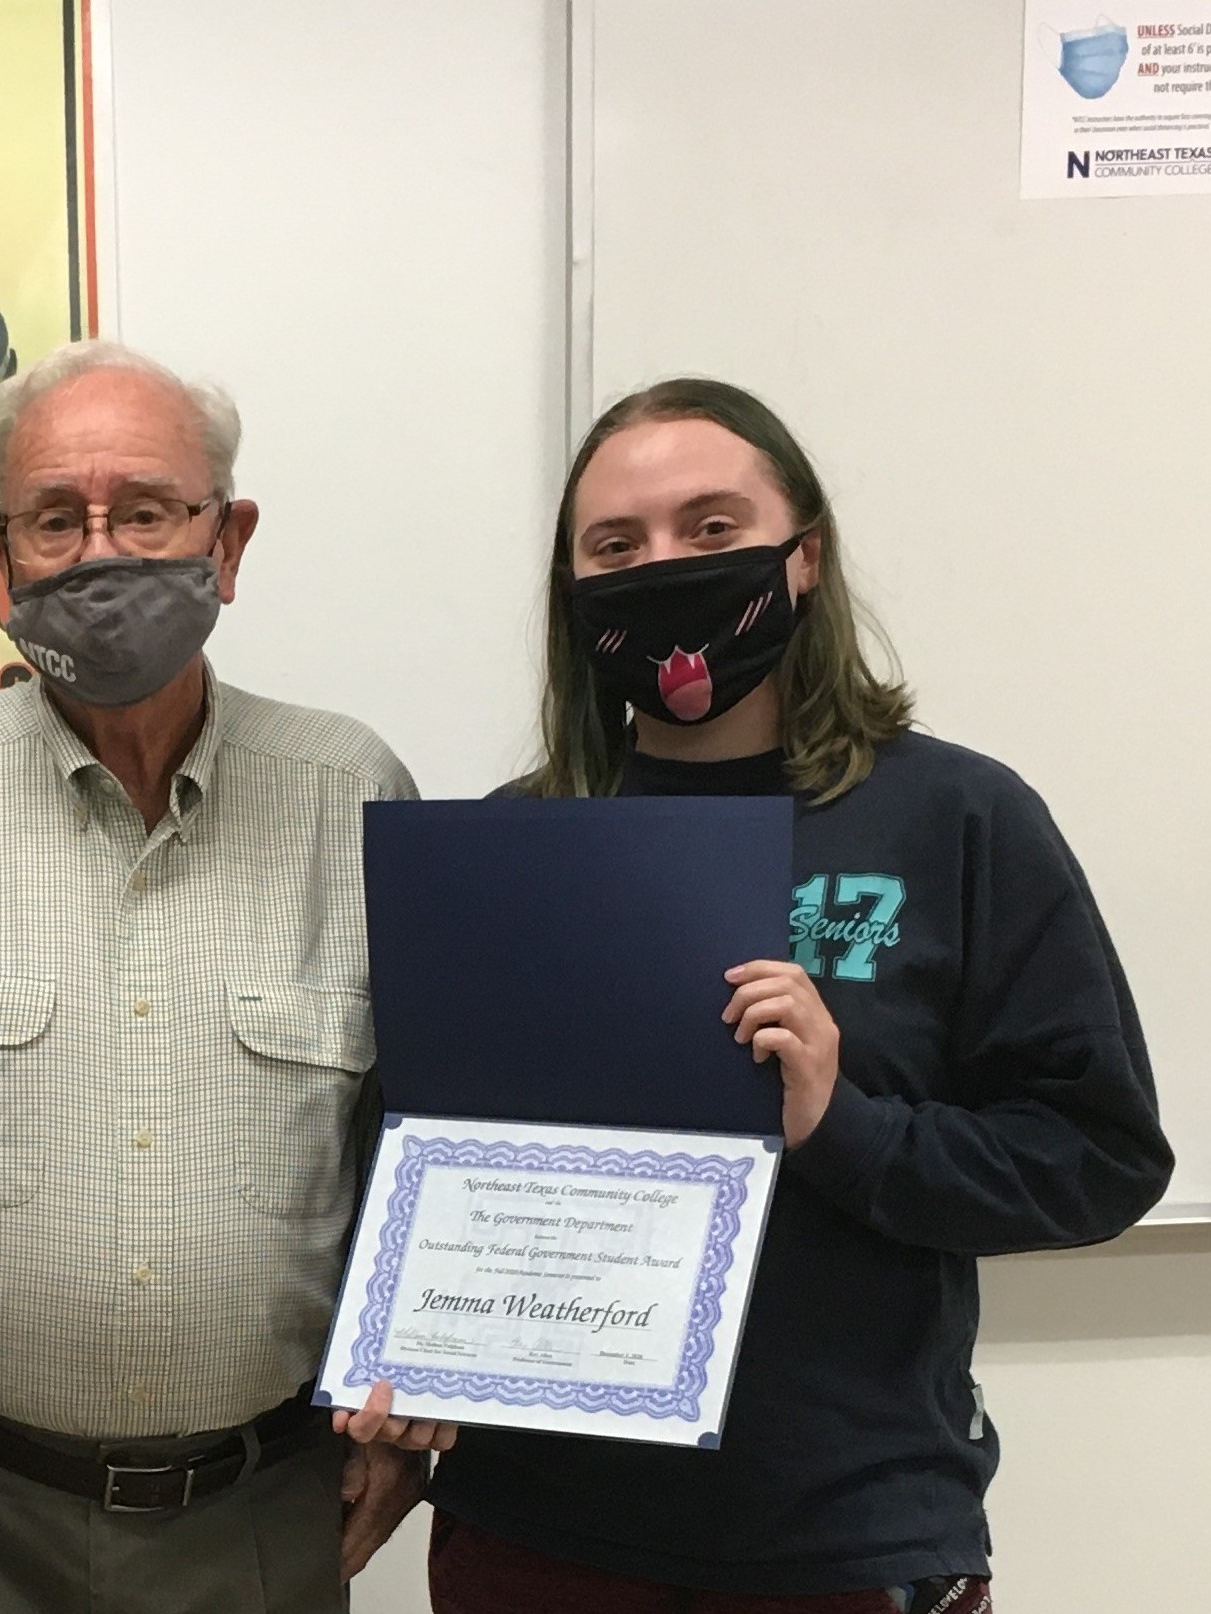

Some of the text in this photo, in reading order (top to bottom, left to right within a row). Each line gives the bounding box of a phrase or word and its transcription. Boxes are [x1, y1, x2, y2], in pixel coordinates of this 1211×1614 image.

[1137, 24, 1175, 38] UNLESS
[1177, 23, 1204, 36] Social
[1141, 43, 1152, 56] of
[1152, 44, 1162, 55] at
[1164, 43, 1186, 55] least
[1197, 44, 1204, 54] is
[1137, 62, 1211, 77] AND your instru
[1154, 82, 1169, 93] not
[1171, 82, 1203, 95] require
[1095, 148, 1171, 162] NORTHEAST
[1094, 165, 1163, 178] COMMUNITY
[789, 904, 901, 948] Seniors
[792, 872, 907, 982] 17
[462, 1178, 679, 1208] Northeast Texas Community College
[470, 1210, 633, 1233] The Government Department
[419, 1239, 684, 1269] Outstanding Federal Government Student Award
[412, 1288, 659, 1333] Jemma Weatherford
